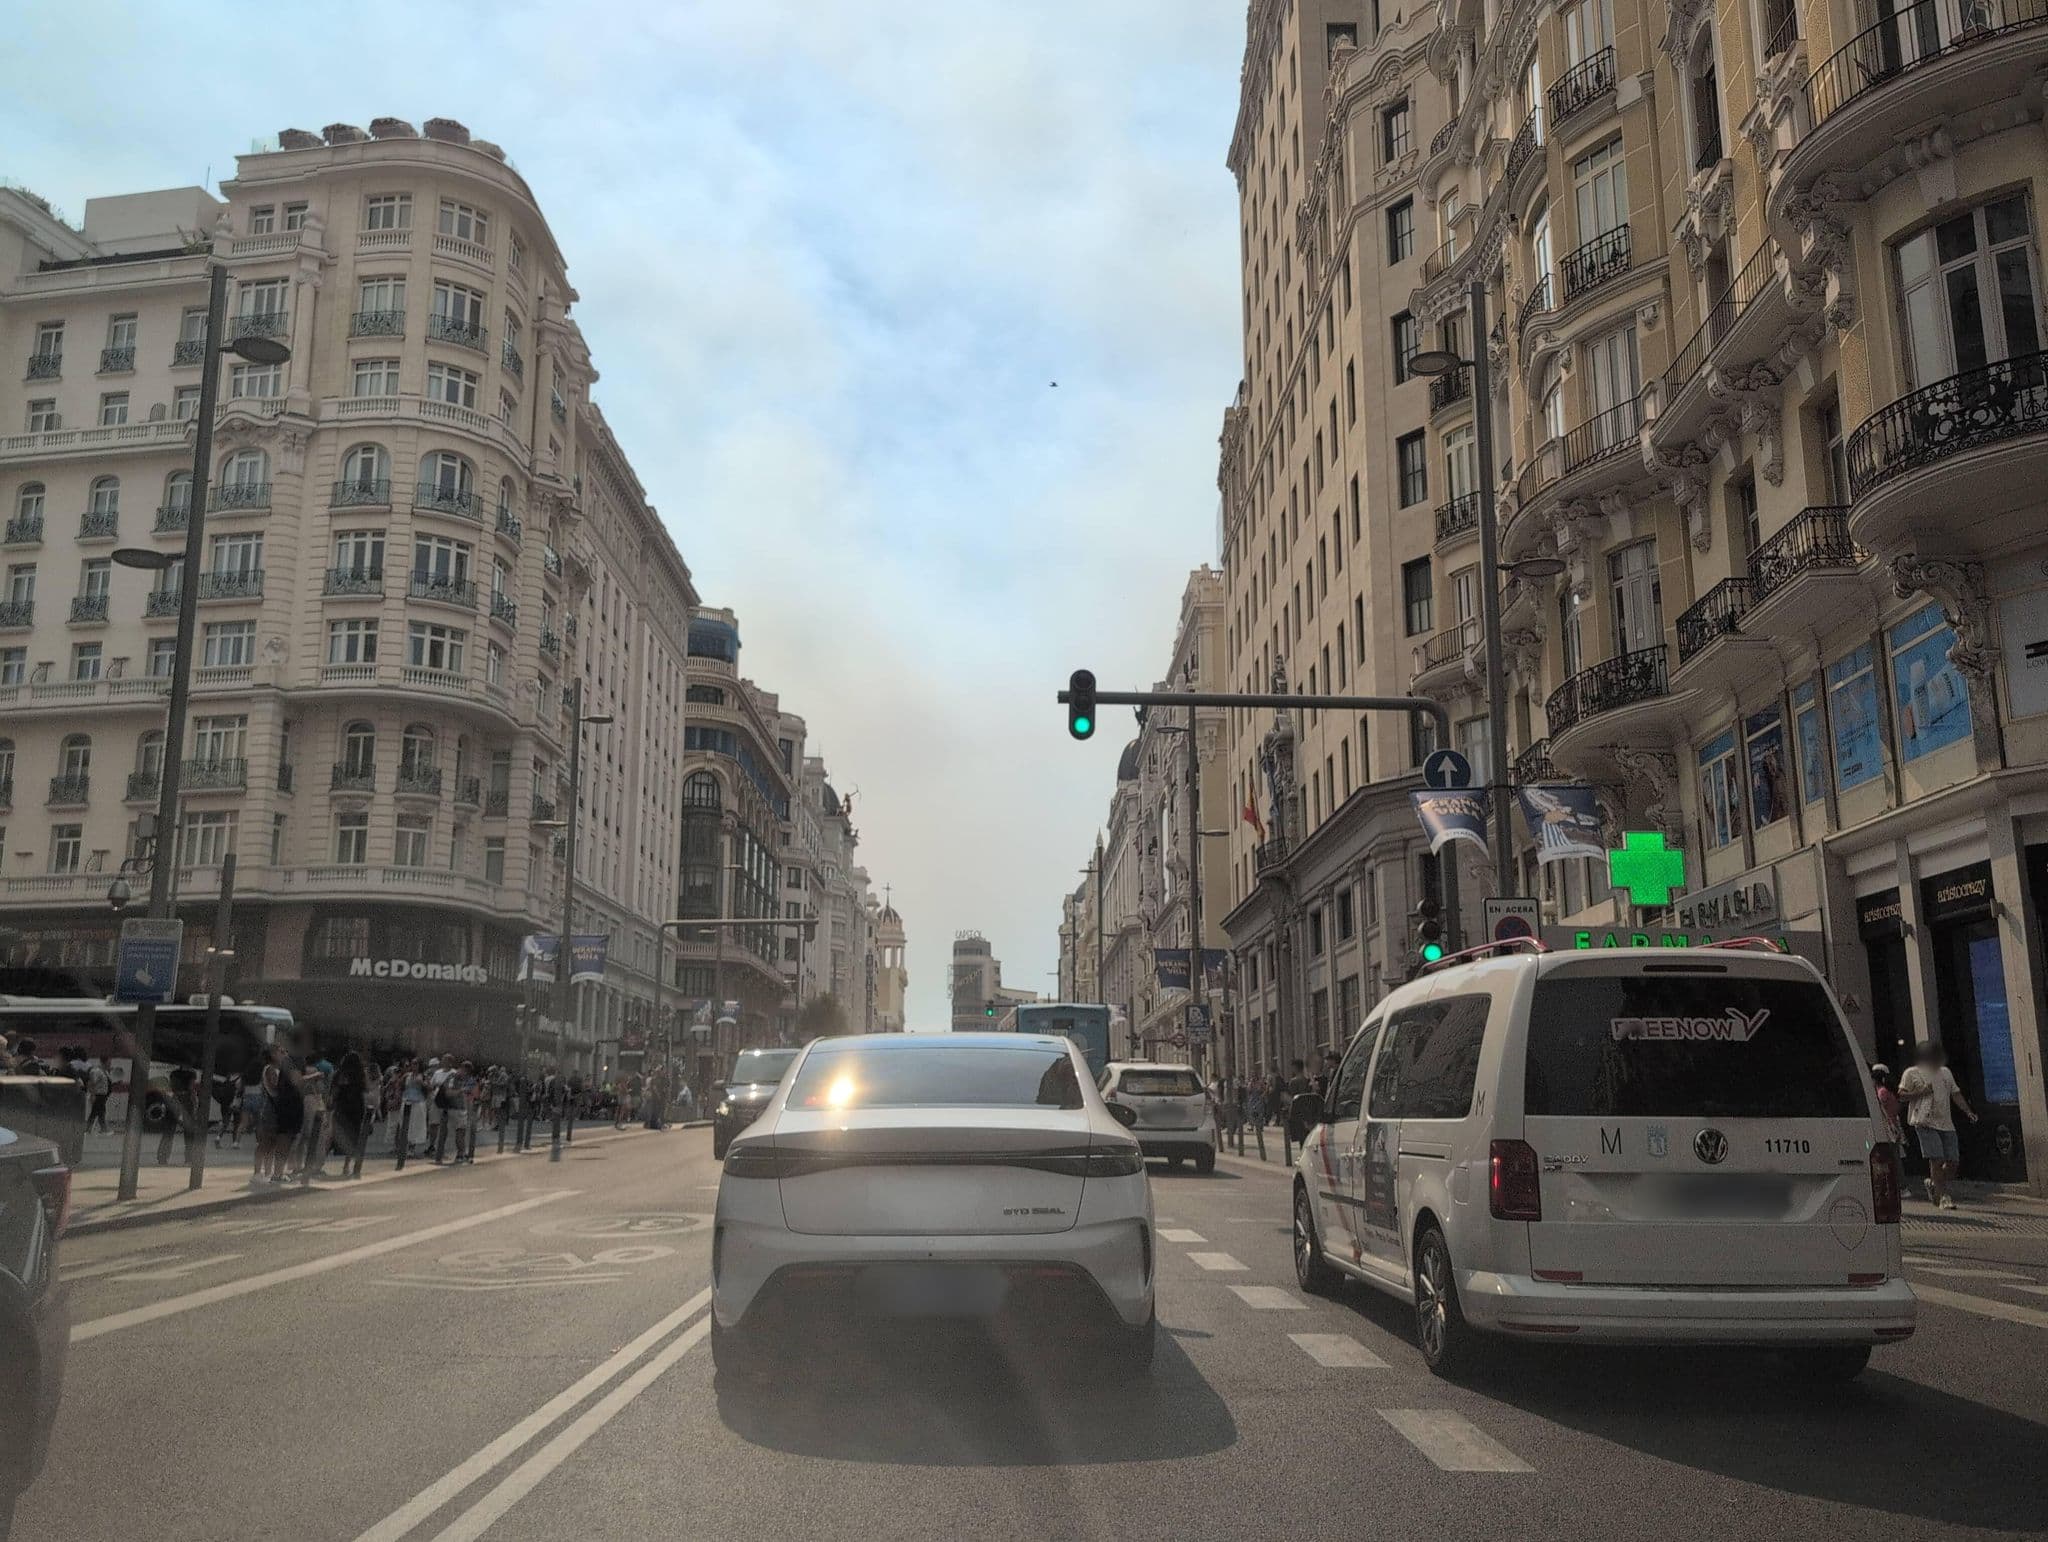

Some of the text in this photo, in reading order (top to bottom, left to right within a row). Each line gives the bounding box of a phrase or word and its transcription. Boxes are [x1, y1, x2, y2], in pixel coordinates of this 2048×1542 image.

[1937, 878, 1986, 904] aristocrazy
[1679, 882, 1773, 929] FARMACIA
[1575, 931, 1789, 954] FARMAA
[350, 957, 488, 984] McDonald's
[1612, 1019, 1734, 1040] FEENOW
[1600, 1127, 1622, 1155] M
[1765, 1139, 1811, 1154] 11710
[1031, 1207, 1066, 1215] SEAL
